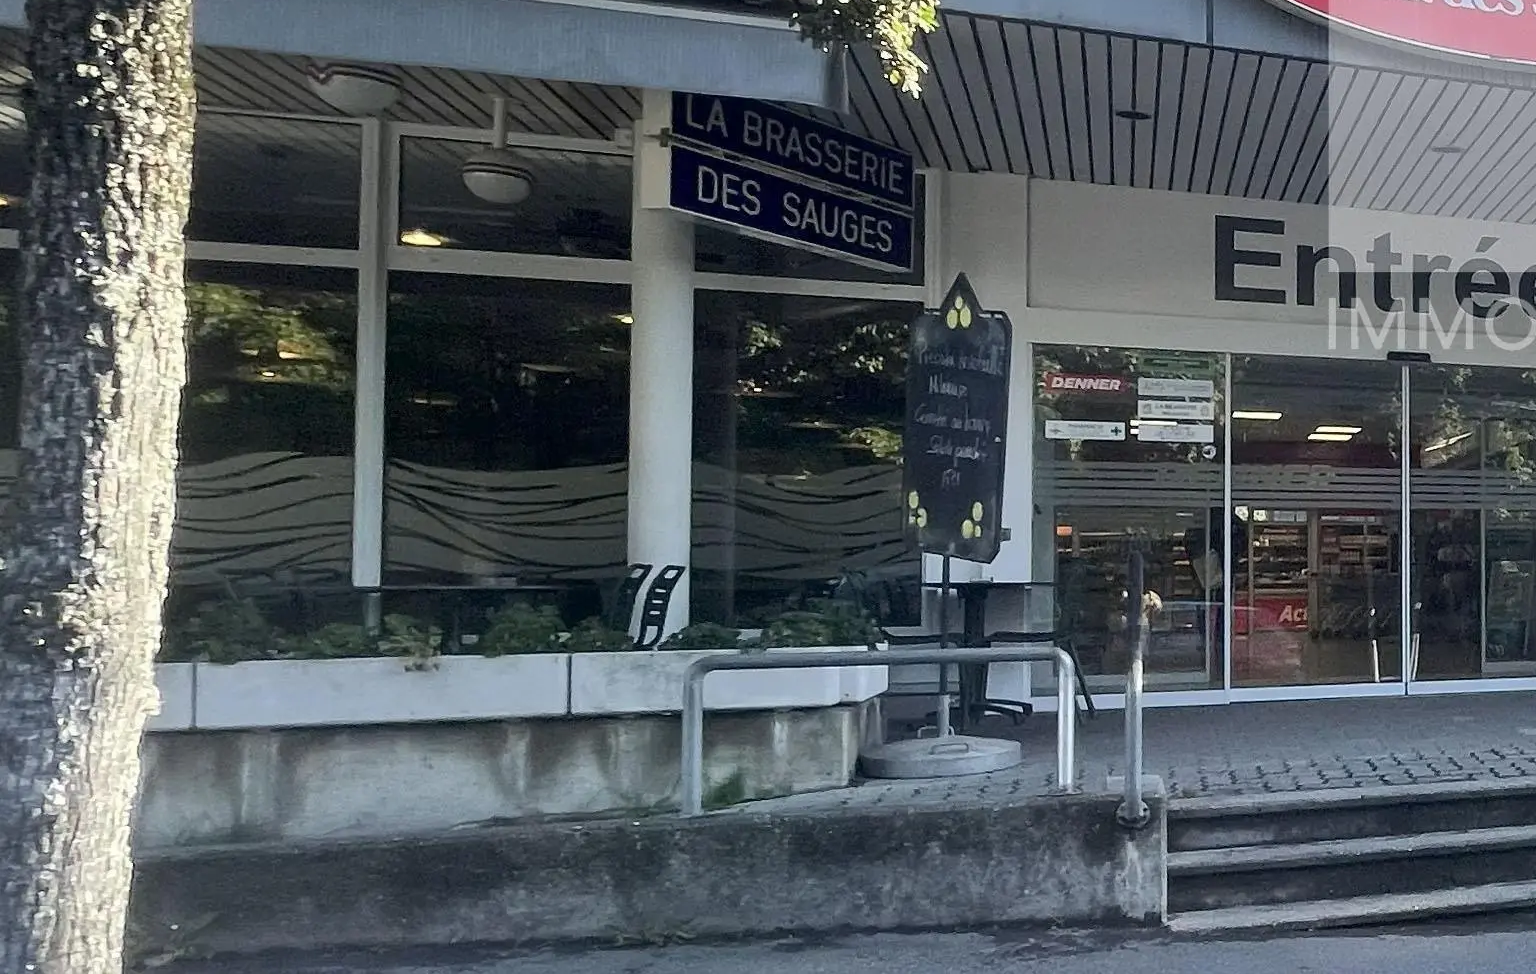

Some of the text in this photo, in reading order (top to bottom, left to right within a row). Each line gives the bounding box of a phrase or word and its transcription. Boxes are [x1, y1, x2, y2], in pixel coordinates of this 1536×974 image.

[686, 93, 904, 195] LA BRASSERIE
[697, 165, 893, 252] DES SAUGES
[1051, 377, 1121, 390] DENNER
